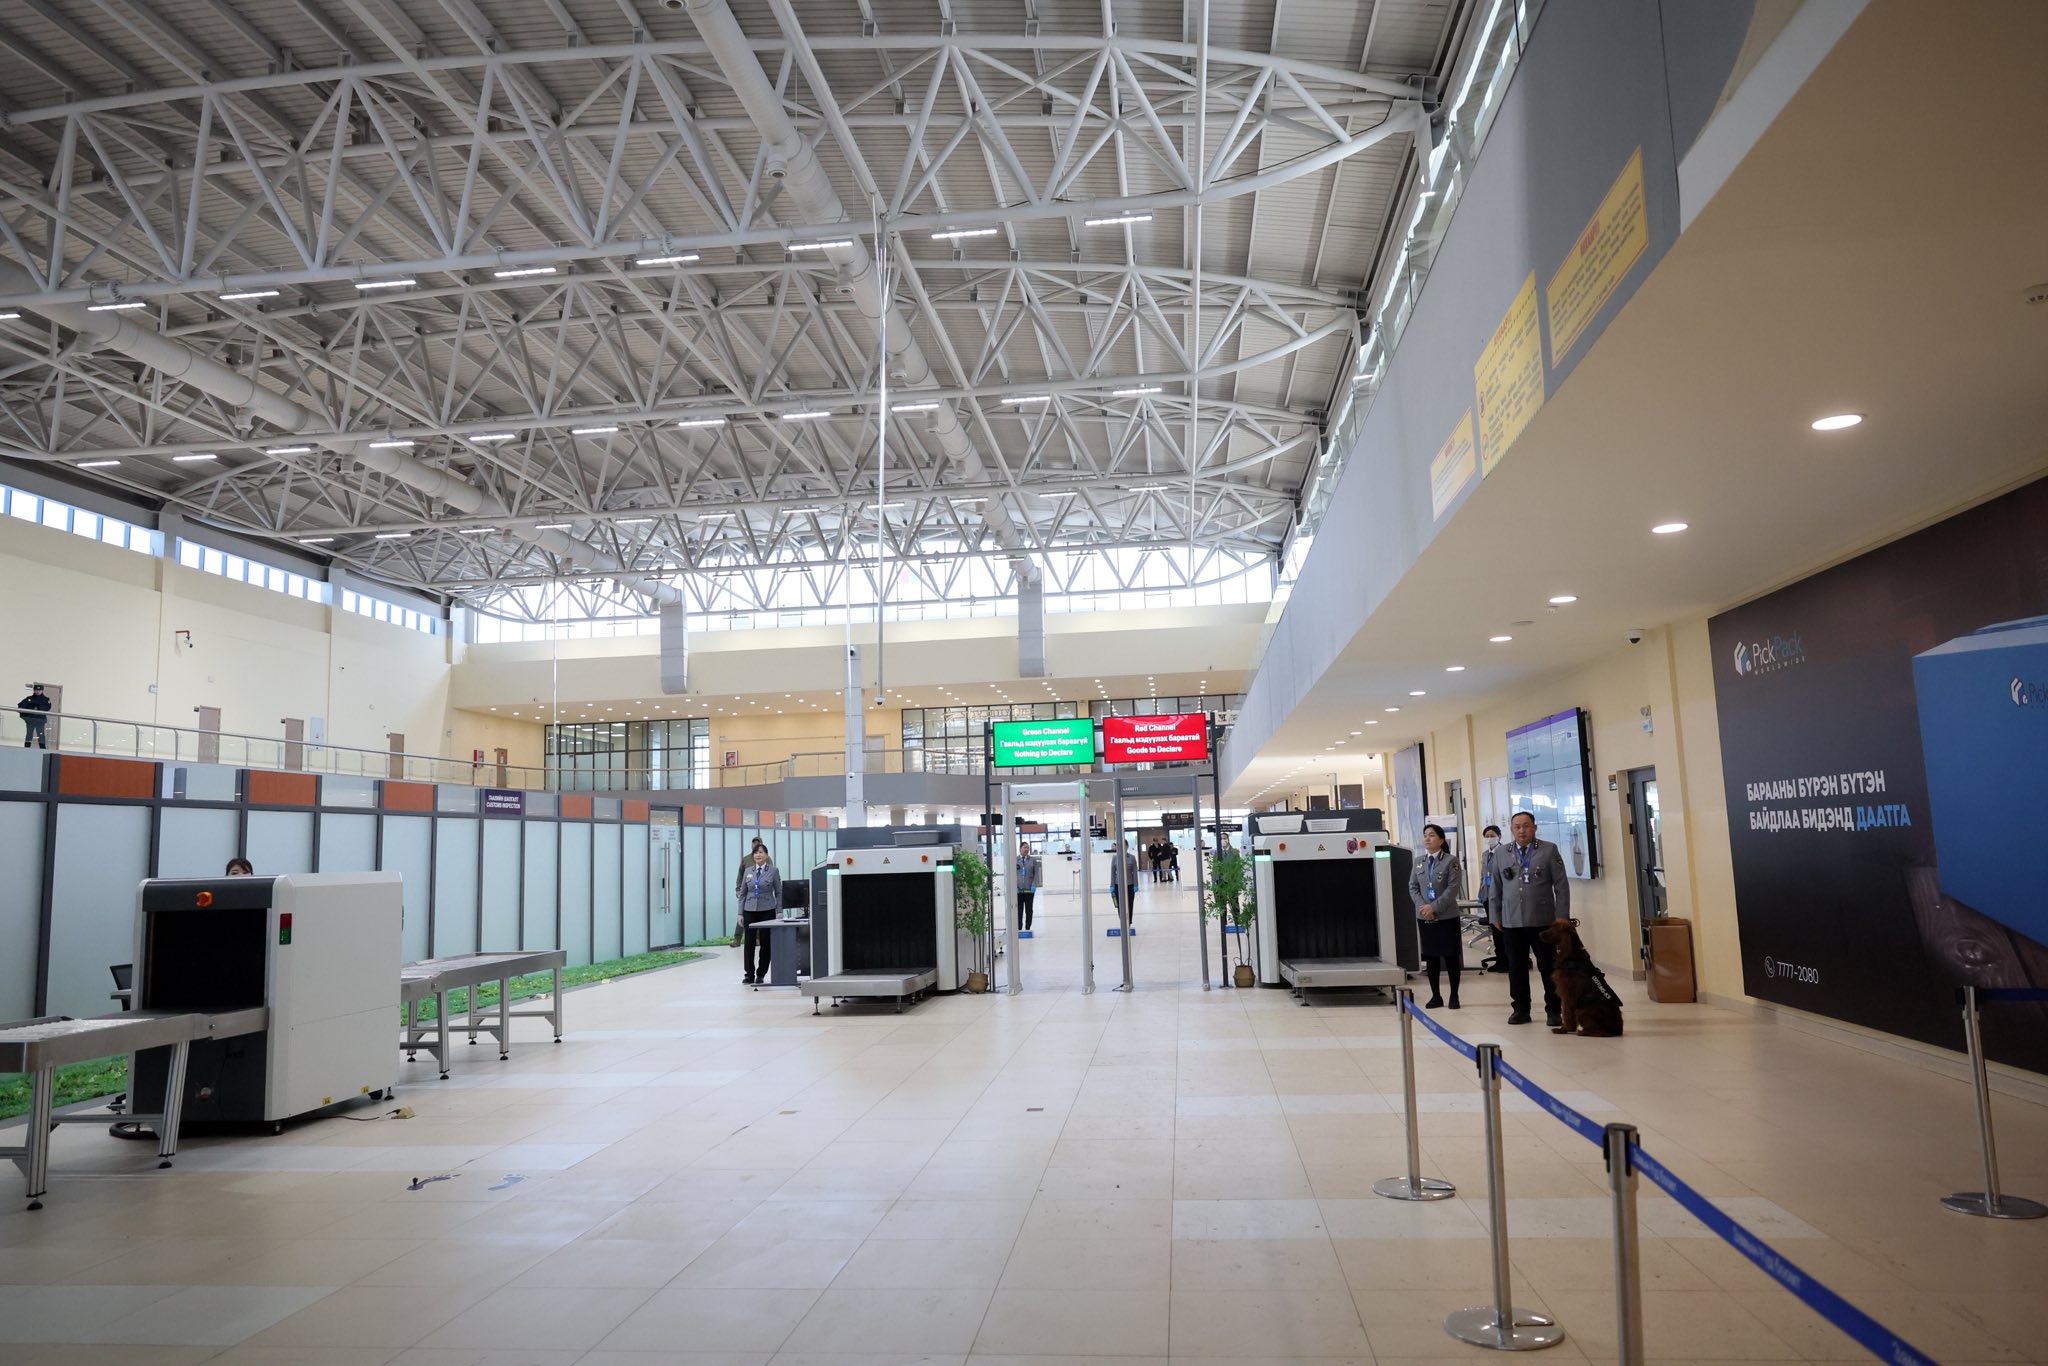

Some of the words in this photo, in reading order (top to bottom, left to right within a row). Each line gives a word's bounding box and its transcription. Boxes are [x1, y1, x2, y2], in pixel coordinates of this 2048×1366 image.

[1752, 631, 1802, 668] PickPack
[1022, 728, 1042, 736] Green
[1043, 727, 1070, 735] Channel
[1134, 724, 1148, 732] Red
[1148, 723, 1176, 732] Channel
[1000, 740, 1024, 748] Гаальд
[1110, 736, 1135, 744] Гаальд
[1014, 750, 1040, 758] Nothing
[1048, 748, 1073, 756] Declare
[1126, 746, 1149, 754] Goods
[1157, 745, 1183, 753] Declare
[1746, 778, 1797, 802] БАРААНЫ
[1798, 774, 1839, 798] БҮРЭН
[1839, 769, 1886, 795] БҮТЭН
[1749, 806, 1801, 832] БАЙДЛАА
[1801, 807, 1855, 832] БИДЭНД
[1856, 804, 1912, 831] ДААТГА
[1777, 961, 1819, 984] 7777-2080
